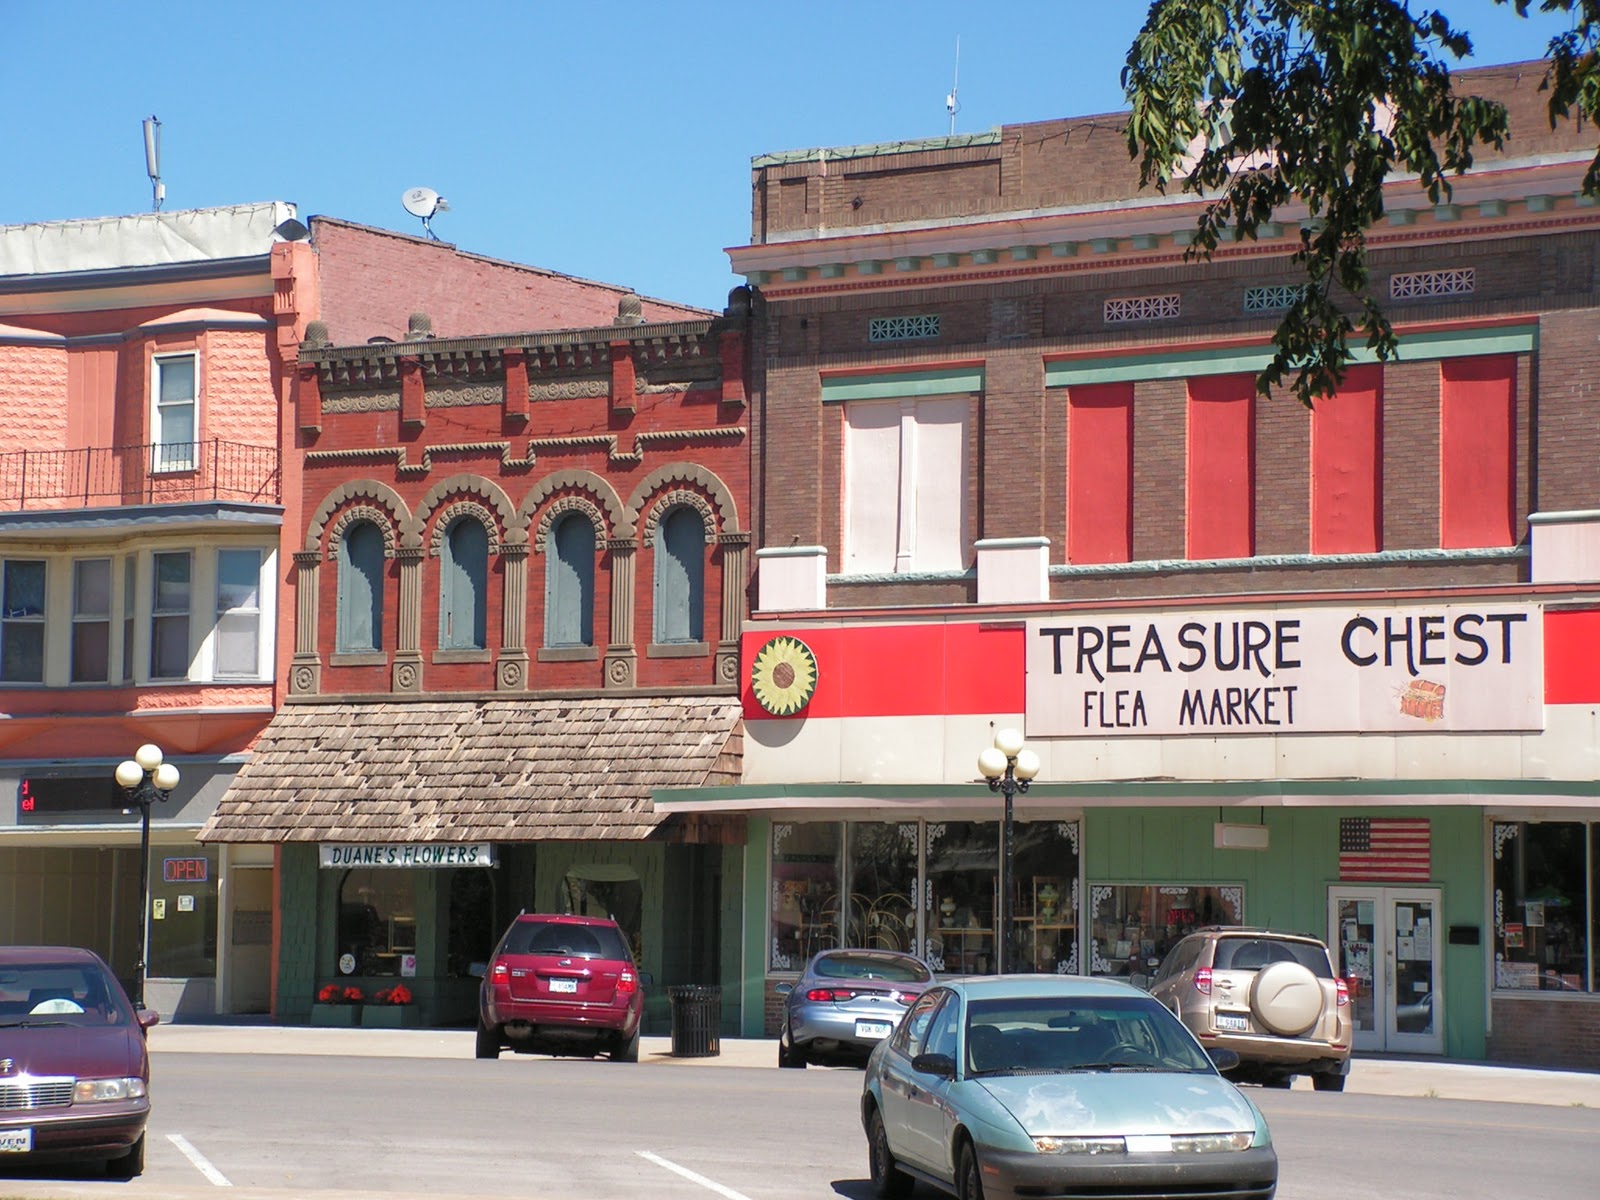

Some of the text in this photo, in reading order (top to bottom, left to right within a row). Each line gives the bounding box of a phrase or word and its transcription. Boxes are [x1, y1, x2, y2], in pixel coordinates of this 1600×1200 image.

[1039, 613, 1528, 683] TREASURE CHEST
[1083, 685, 1298, 728] FLEA MARKET
[332, 846, 479, 863] DUANE'S FLOWERS
[166, 860, 207, 880] OPEN
[1167, 910, 1195, 924] OPEN
